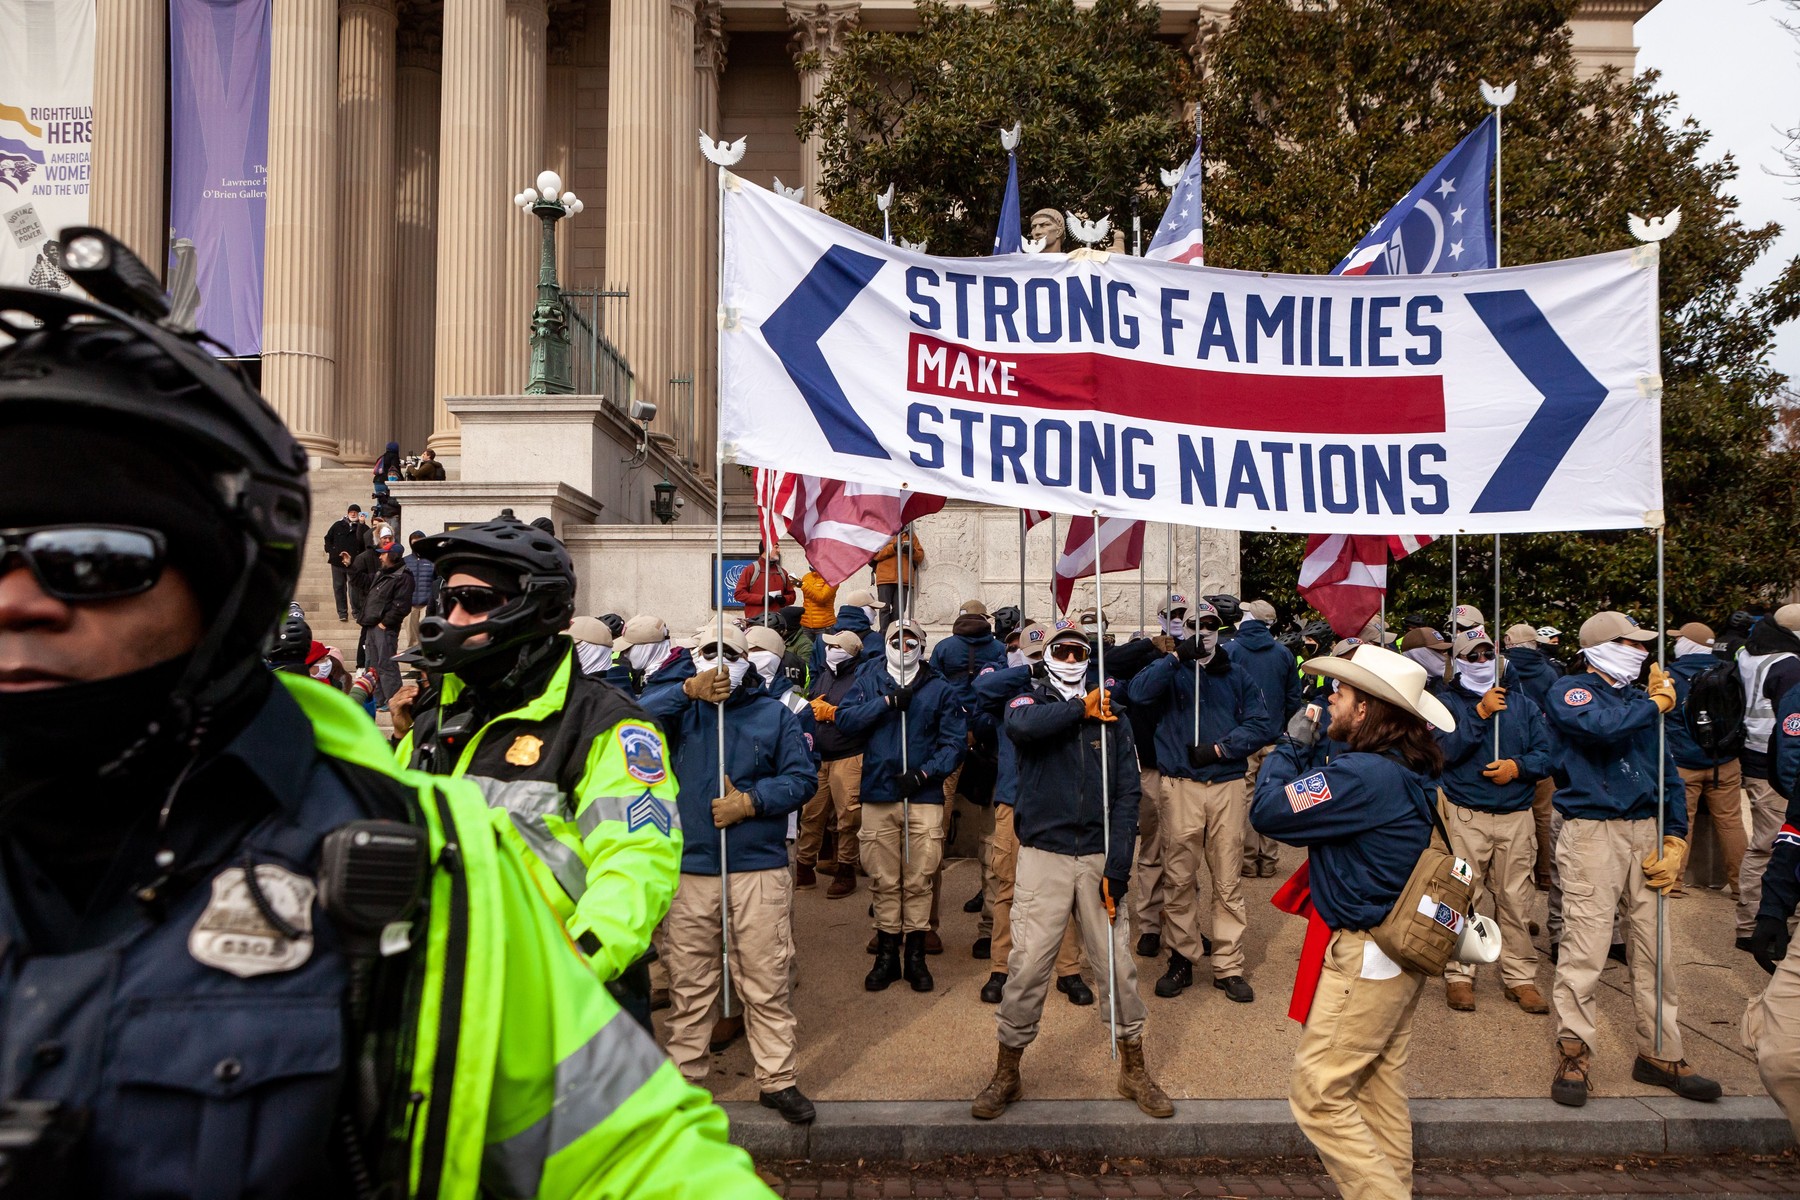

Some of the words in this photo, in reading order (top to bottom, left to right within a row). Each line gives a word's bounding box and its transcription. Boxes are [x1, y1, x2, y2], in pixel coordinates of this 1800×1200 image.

[31, 106, 93, 120] RIGHTFULLY
[48, 121, 92, 144] HERS
[51, 152, 91, 164] AMERICA
[222, 178, 261, 186] Lawrence
[32, 185, 52, 195] AND
[55, 184, 71, 195] THE
[74, 184, 89, 195] VOT
[203, 189, 237, 199] O'Brien
[239, 189, 268, 200] Gallery
[14, 221, 40, 236] PEOPLE
[18, 229, 42, 243] POWER
[905, 265, 1141, 350] STRONG
[1160, 287, 1443, 367] FAMILIES
[916, 343, 1019, 397] MAKE
[906, 402, 1156, 500] STRONG
[1177, 433, 1450, 515] NATIONS
